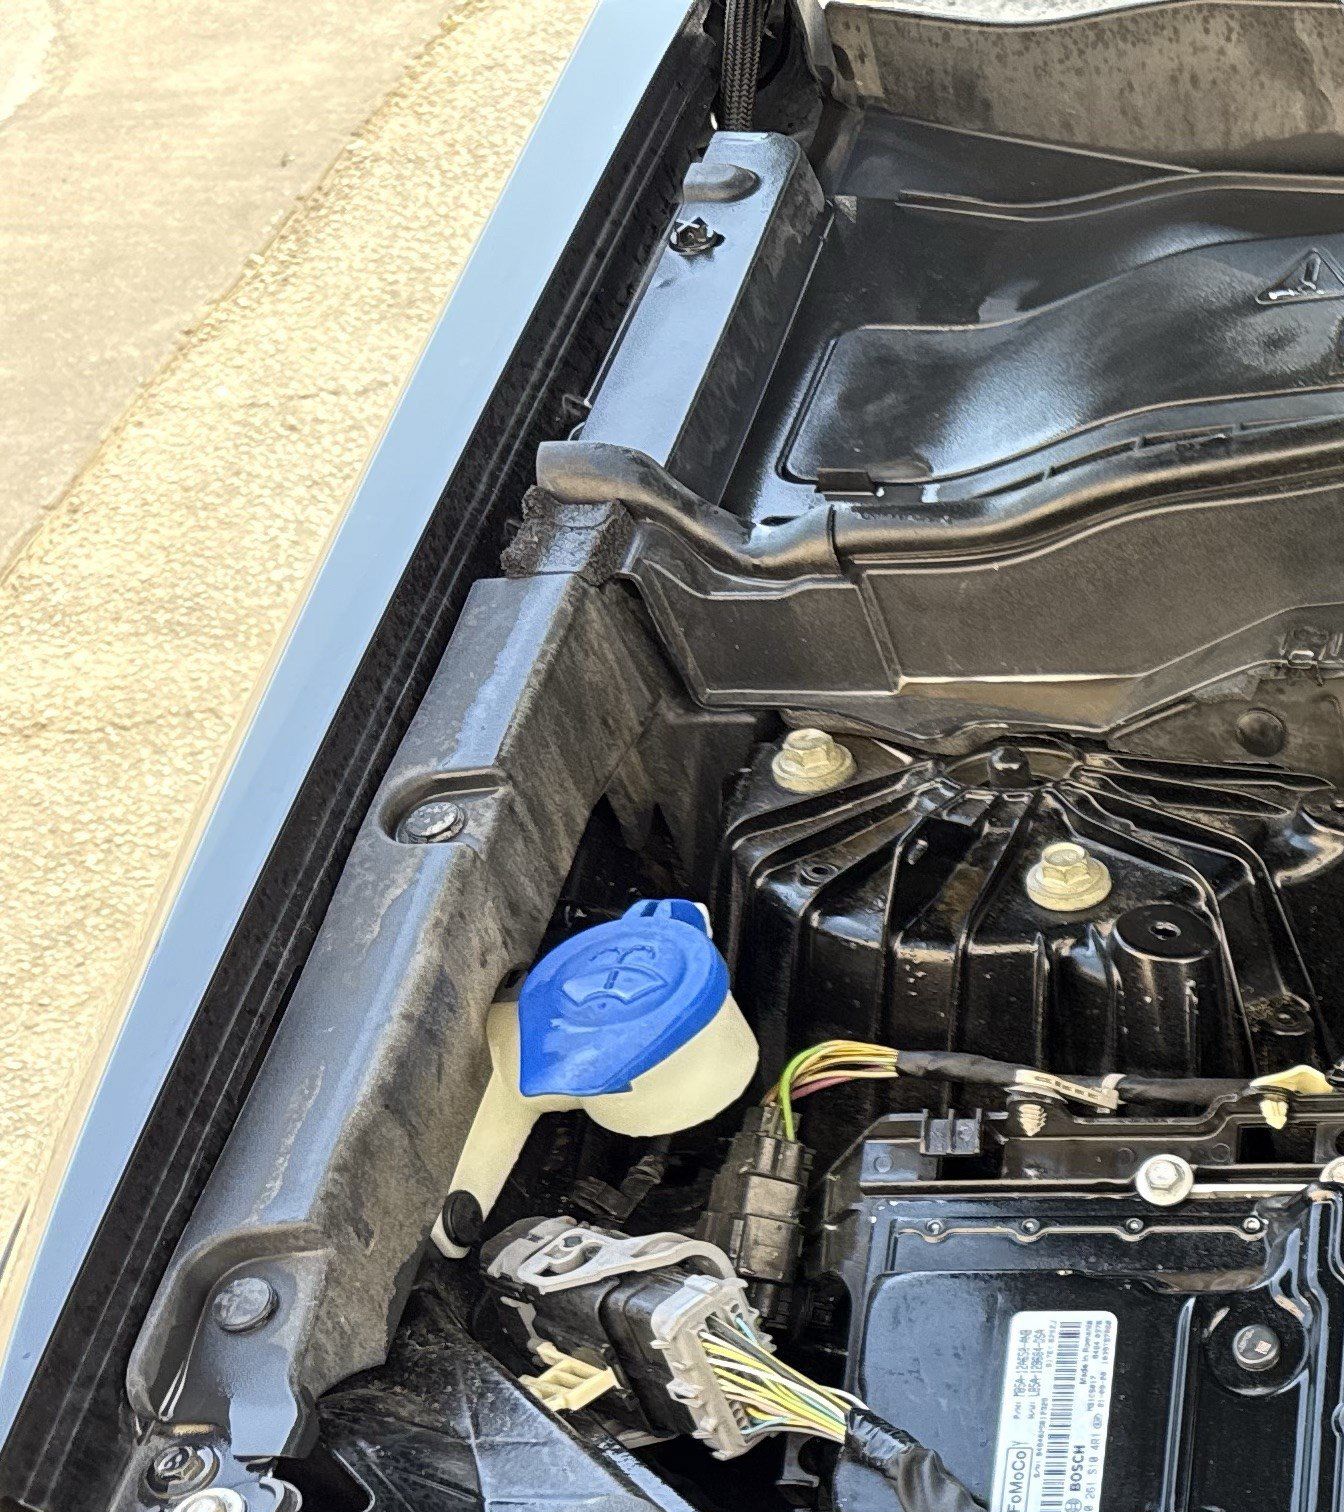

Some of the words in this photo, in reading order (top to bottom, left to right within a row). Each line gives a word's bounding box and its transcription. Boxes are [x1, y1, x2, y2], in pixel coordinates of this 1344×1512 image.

[1079, 1363, 1089, 1385] Made
[1006, 1450, 1027, 1512] FoMoCo
[1070, 1445, 1086, 1492] BOSCH
